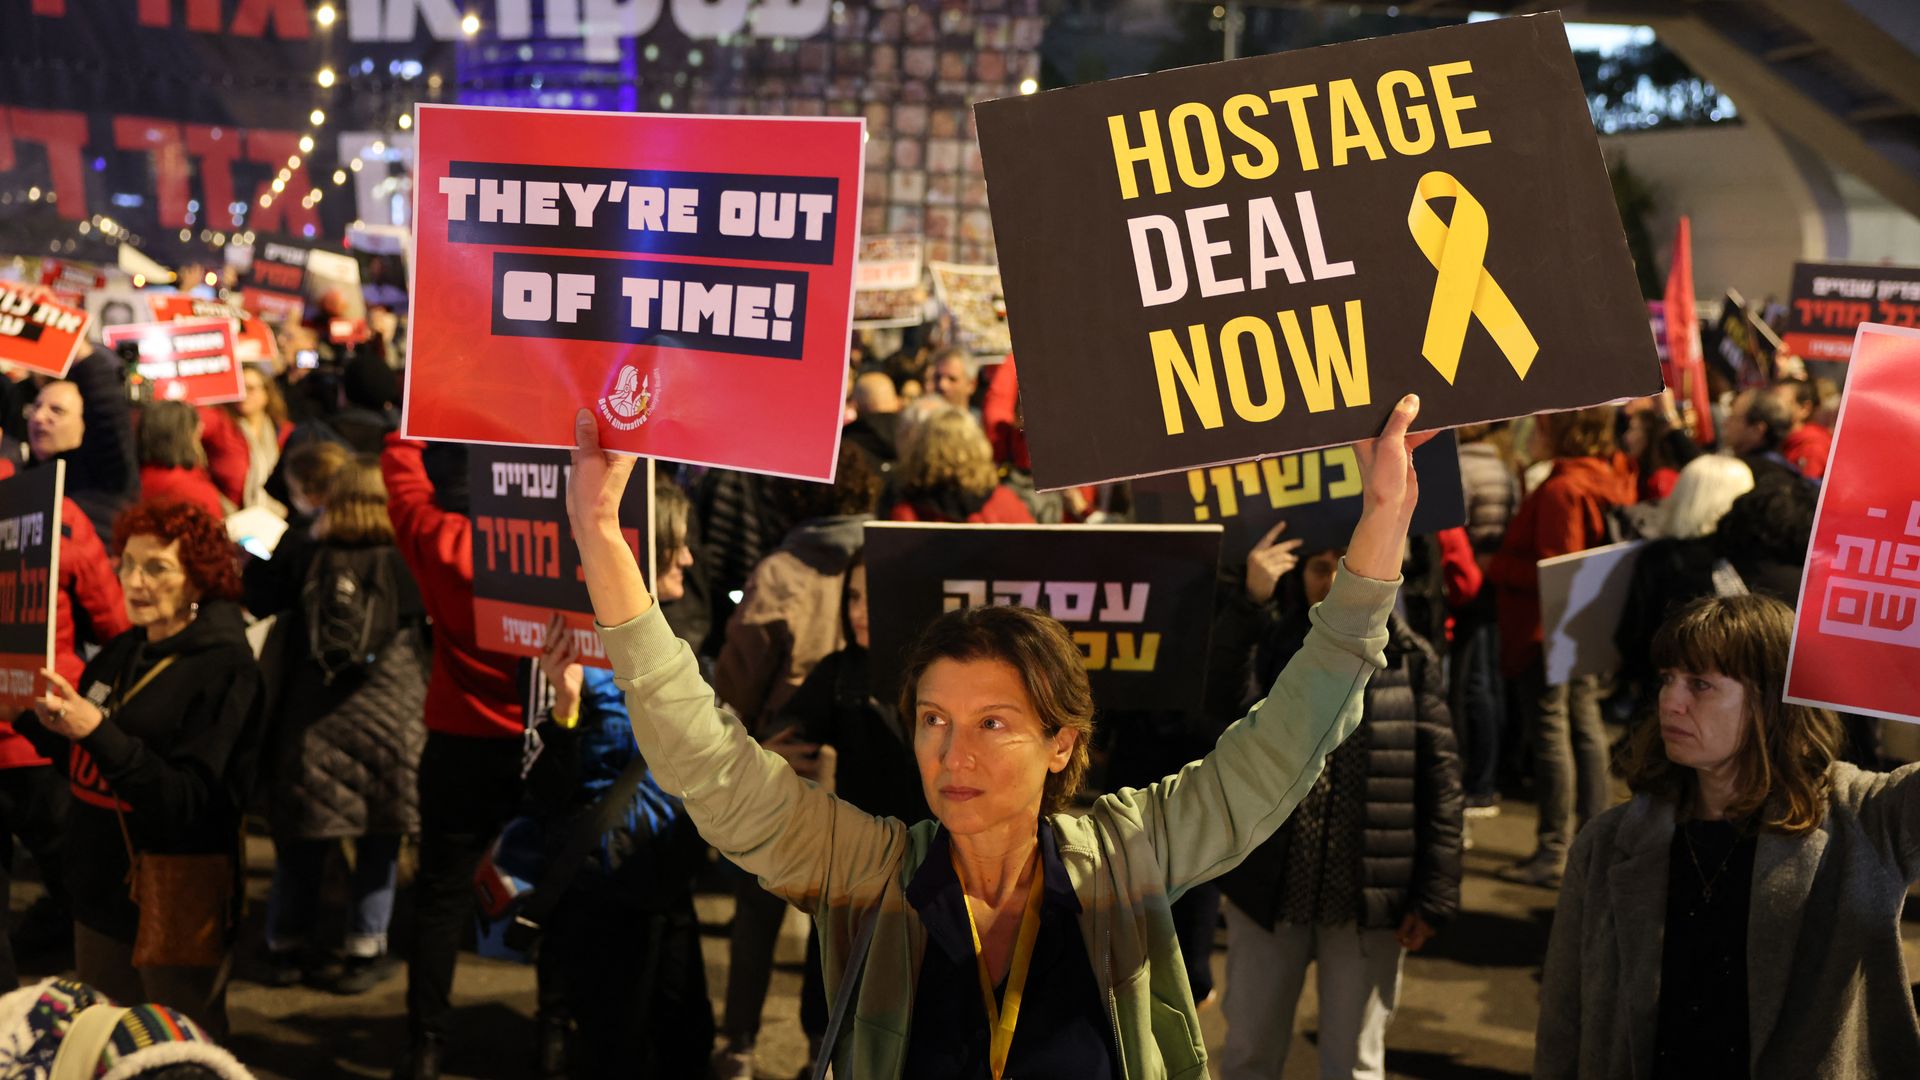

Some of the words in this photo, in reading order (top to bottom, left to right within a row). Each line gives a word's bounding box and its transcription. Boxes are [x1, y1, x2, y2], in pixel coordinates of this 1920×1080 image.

[1108, 61, 1492, 200] HOSTAGE
[438, 176, 699, 234] THEY'RE
[719, 190, 833, 241] OUT
[1126, 191, 1356, 308] DEAL
[502, 270, 596, 323] OF
[622, 276, 795, 342] TIME!
[1148, 299, 1372, 436] NOW
[492, 461, 559, 499] שבויים
[1187, 446, 1363, 521] כשיו!
[476, 515, 561, 580] מחיר
[943, 580, 1150, 623] עסקה
[1826, 585, 1917, 632] שם
